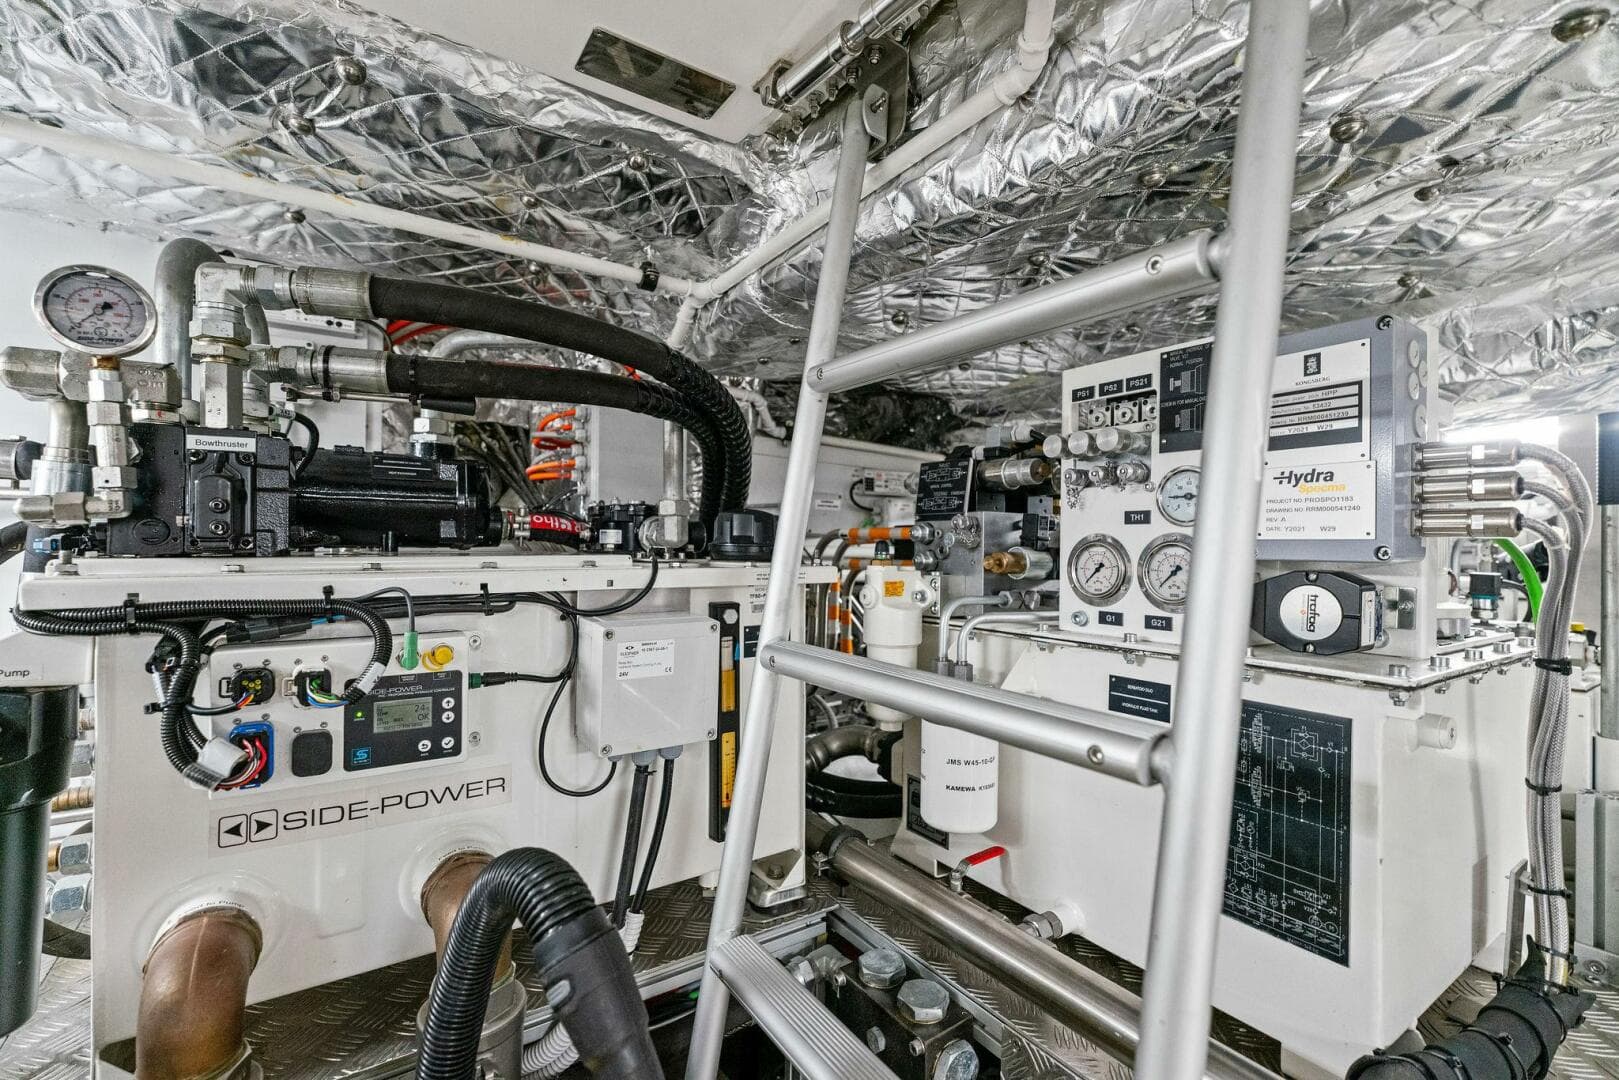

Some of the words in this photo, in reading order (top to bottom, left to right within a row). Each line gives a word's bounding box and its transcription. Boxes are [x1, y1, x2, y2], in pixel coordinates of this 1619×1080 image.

[1129, 377, 1148, 388] PS21
[1103, 383, 1118, 393] PS2
[1076, 390, 1090, 398] PS1
[195, 439, 248, 449] Bowthruster
[1273, 468, 1334, 488] Hydra
[1129, 513, 1144, 521] TH1
[1310, 593, 1320, 633] trafag
[1151, 619, 1166, 627] G21
[945, 784, 976, 792] KAMEWA
[283, 777, 506, 831] SIDE-POWER
